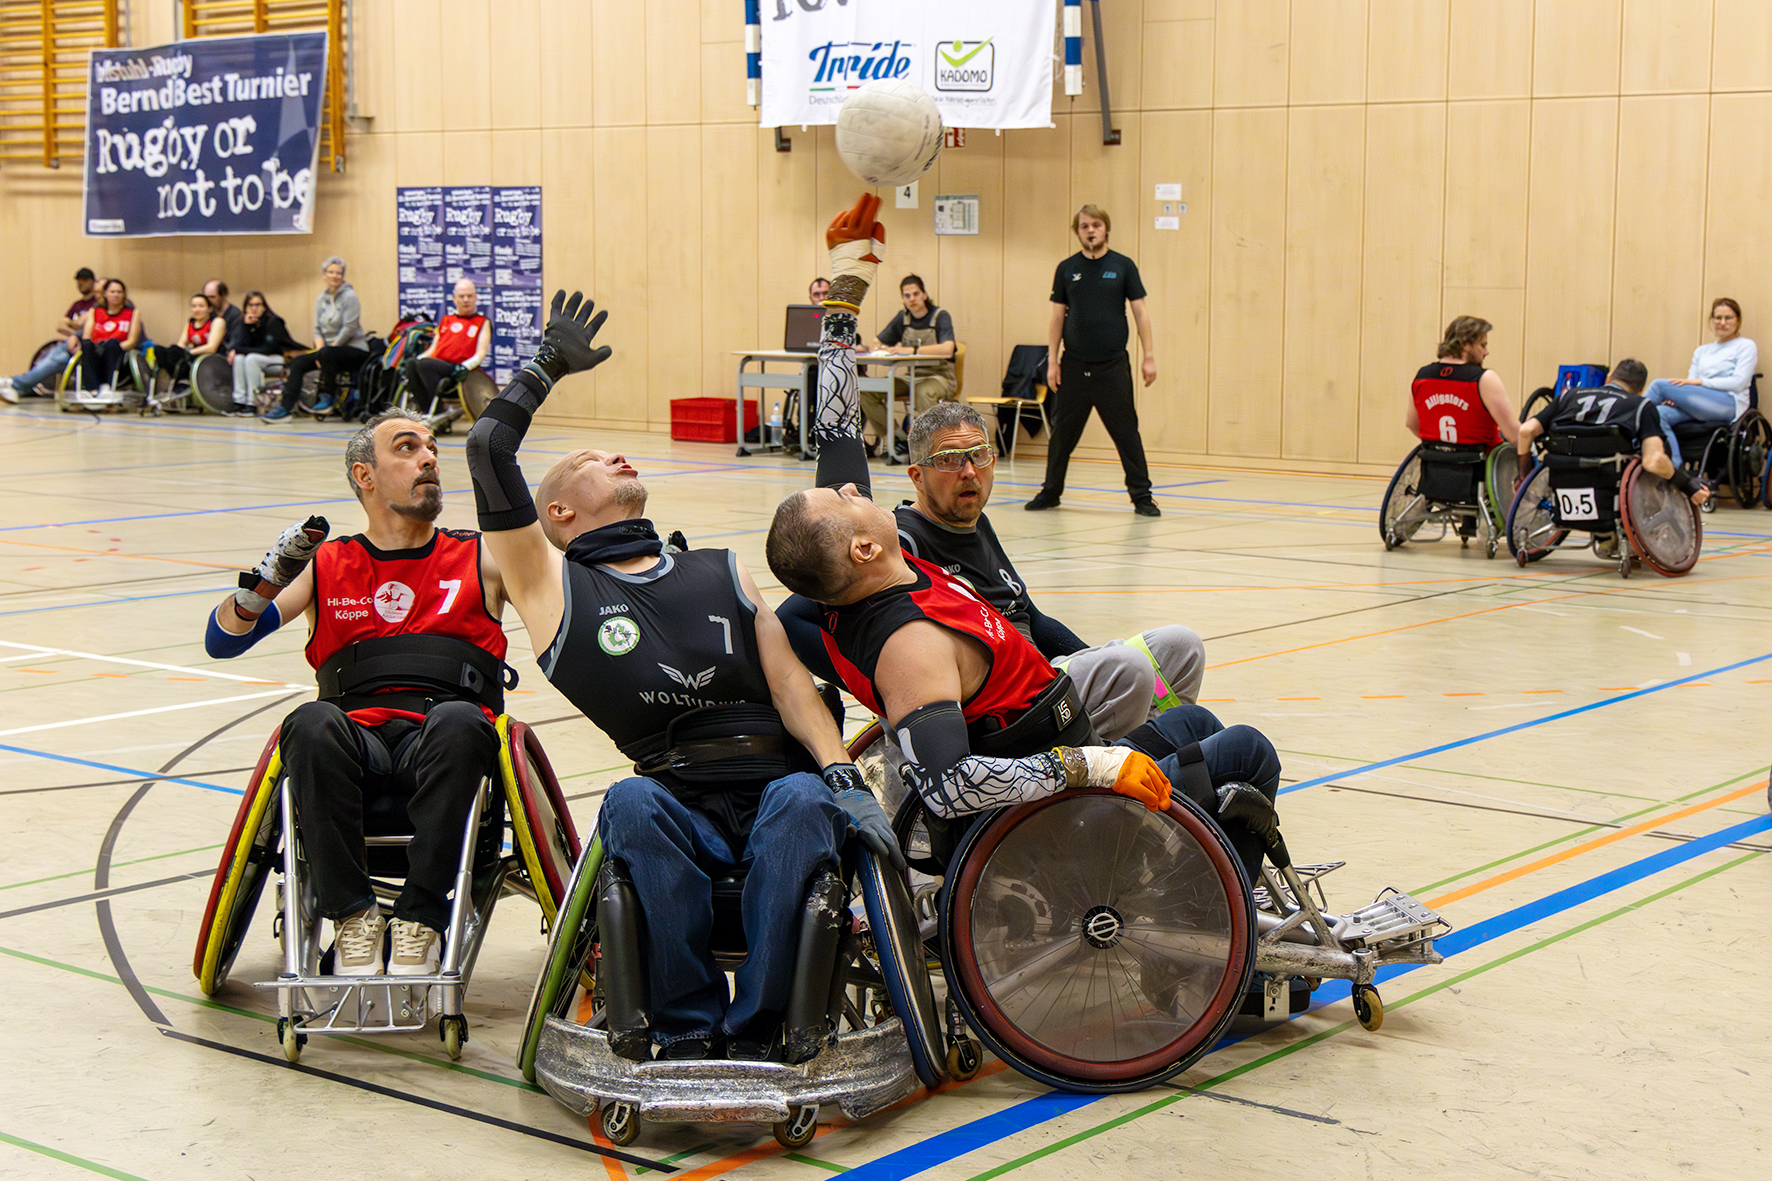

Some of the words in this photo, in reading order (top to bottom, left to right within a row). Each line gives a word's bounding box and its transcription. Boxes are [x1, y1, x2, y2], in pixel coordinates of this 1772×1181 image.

[224, 67, 312, 101] Turnier
[940, 69, 988, 82] KADOMO
[96, 116, 208, 177] Rugby
[214, 115, 257, 158] or
[157, 169, 216, 218] not
[220, 166, 265, 214] to
[904, 186, 912, 199] 4
[1425, 393, 1469, 411] Alligators
[1575, 395, 1617, 424] 11
[1439, 416, 1457, 443] 6
[1562, 494, 1593, 515] 0,5
[999, 568, 1022, 597] 8
[437, 579, 462, 615] 7
[599, 603, 630, 616] JAKO
[335, 610, 369, 620] Köppe
[708, 614, 734, 655] 7
